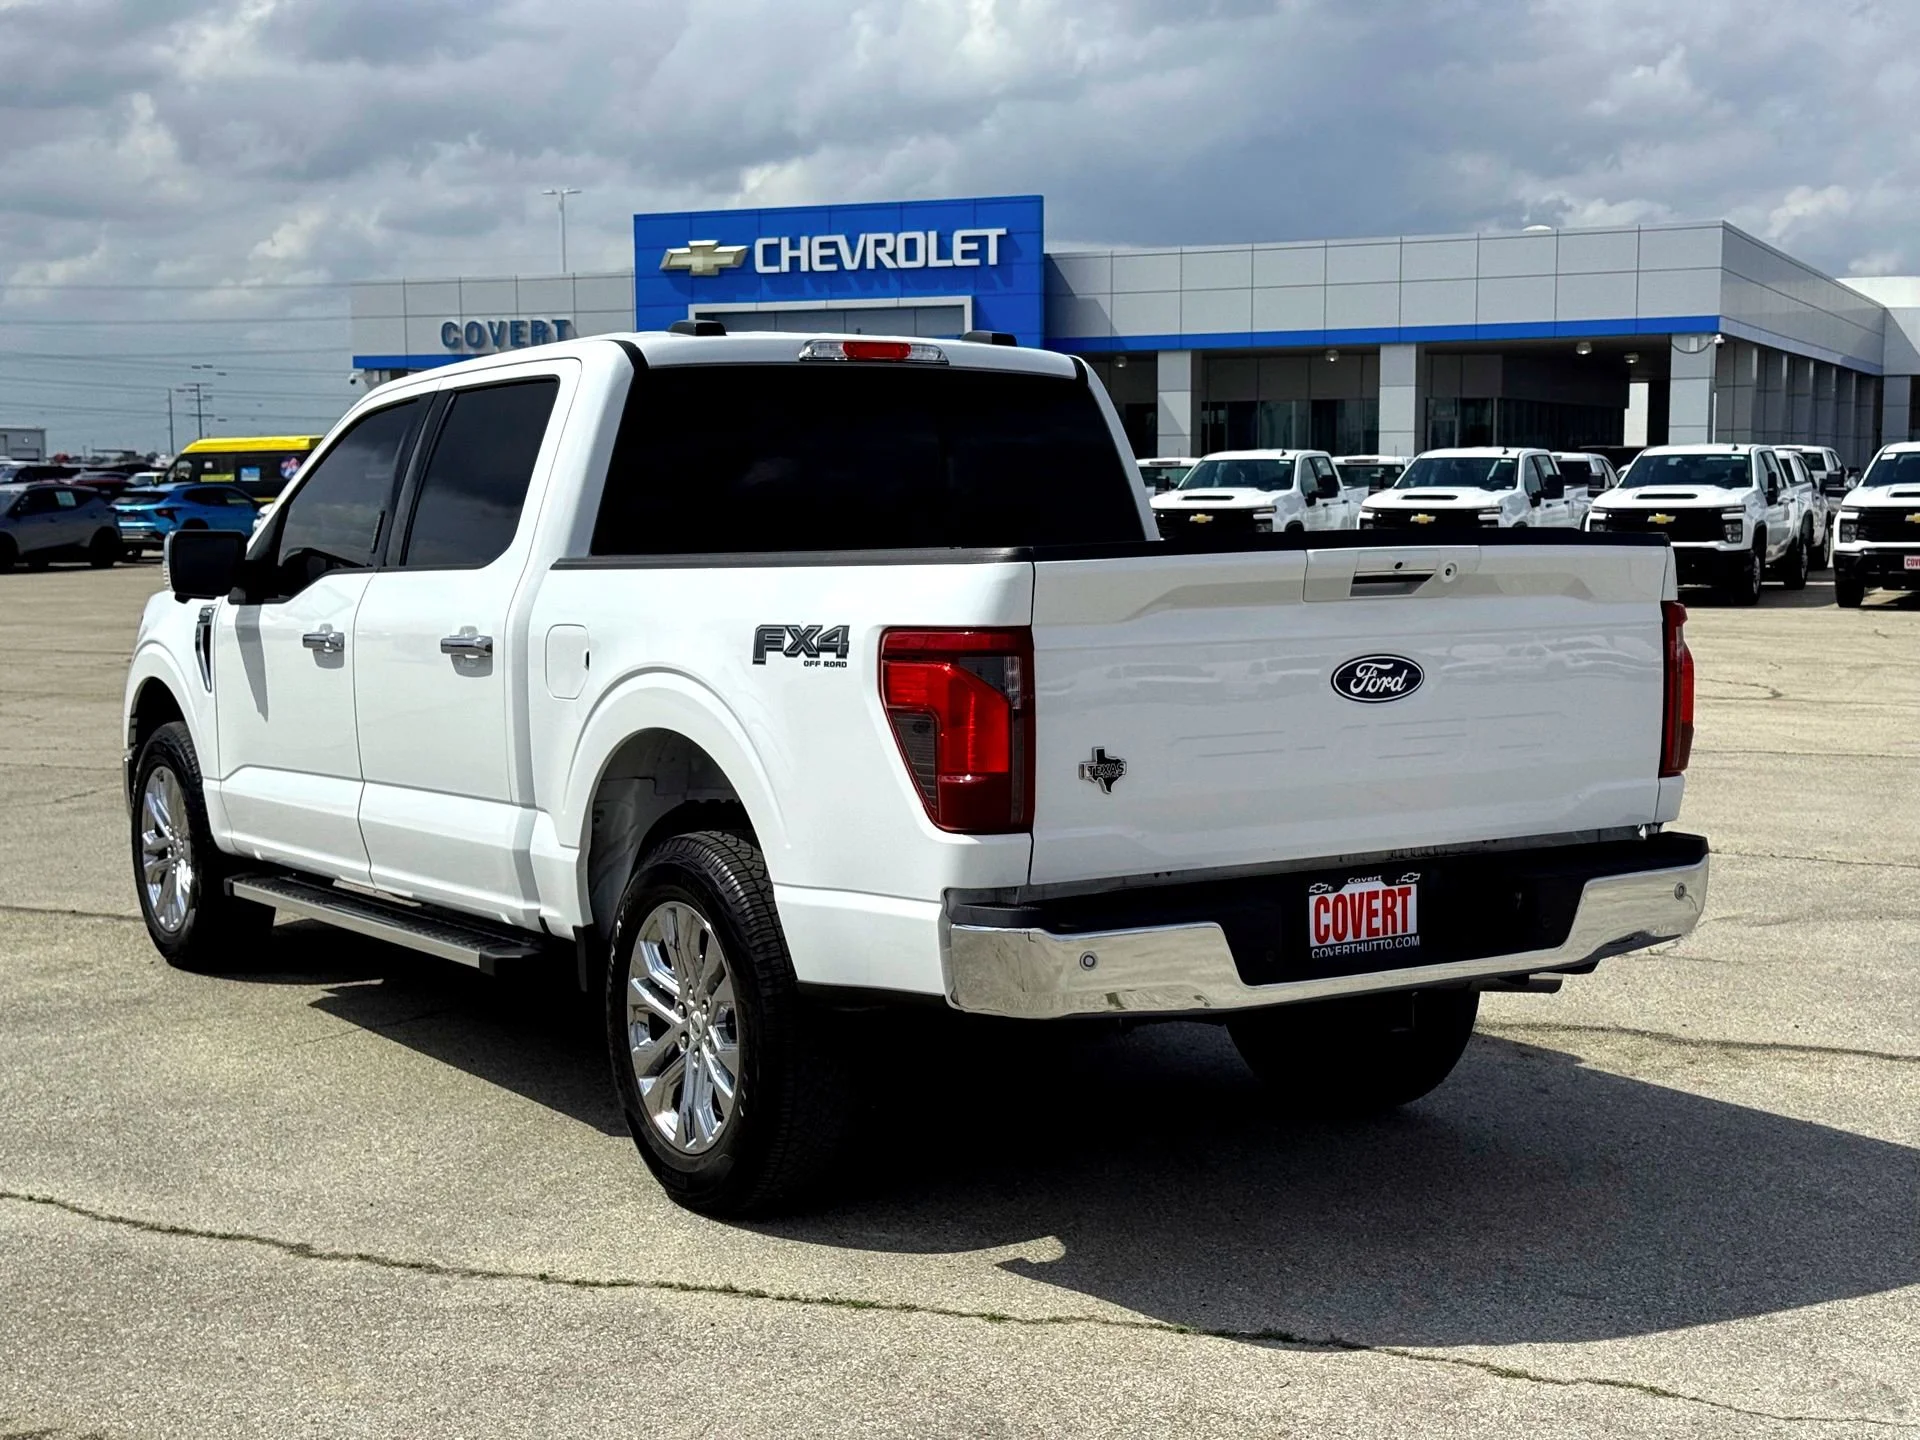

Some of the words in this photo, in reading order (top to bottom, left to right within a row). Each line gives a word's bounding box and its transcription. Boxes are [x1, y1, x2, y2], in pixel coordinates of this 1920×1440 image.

[755, 228, 1007, 274] CHEVROLET
[441, 319, 572, 349] COVERT
[752, 624, 850, 665] FX4
[1350, 662, 1408, 694] Ford
[1086, 763, 1124, 777] TEXAS
[1347, 875, 1382, 884] Covert
[1314, 887, 1412, 944] COVERT
[1312, 935, 1420, 958] COVERTHUTTO.COM
